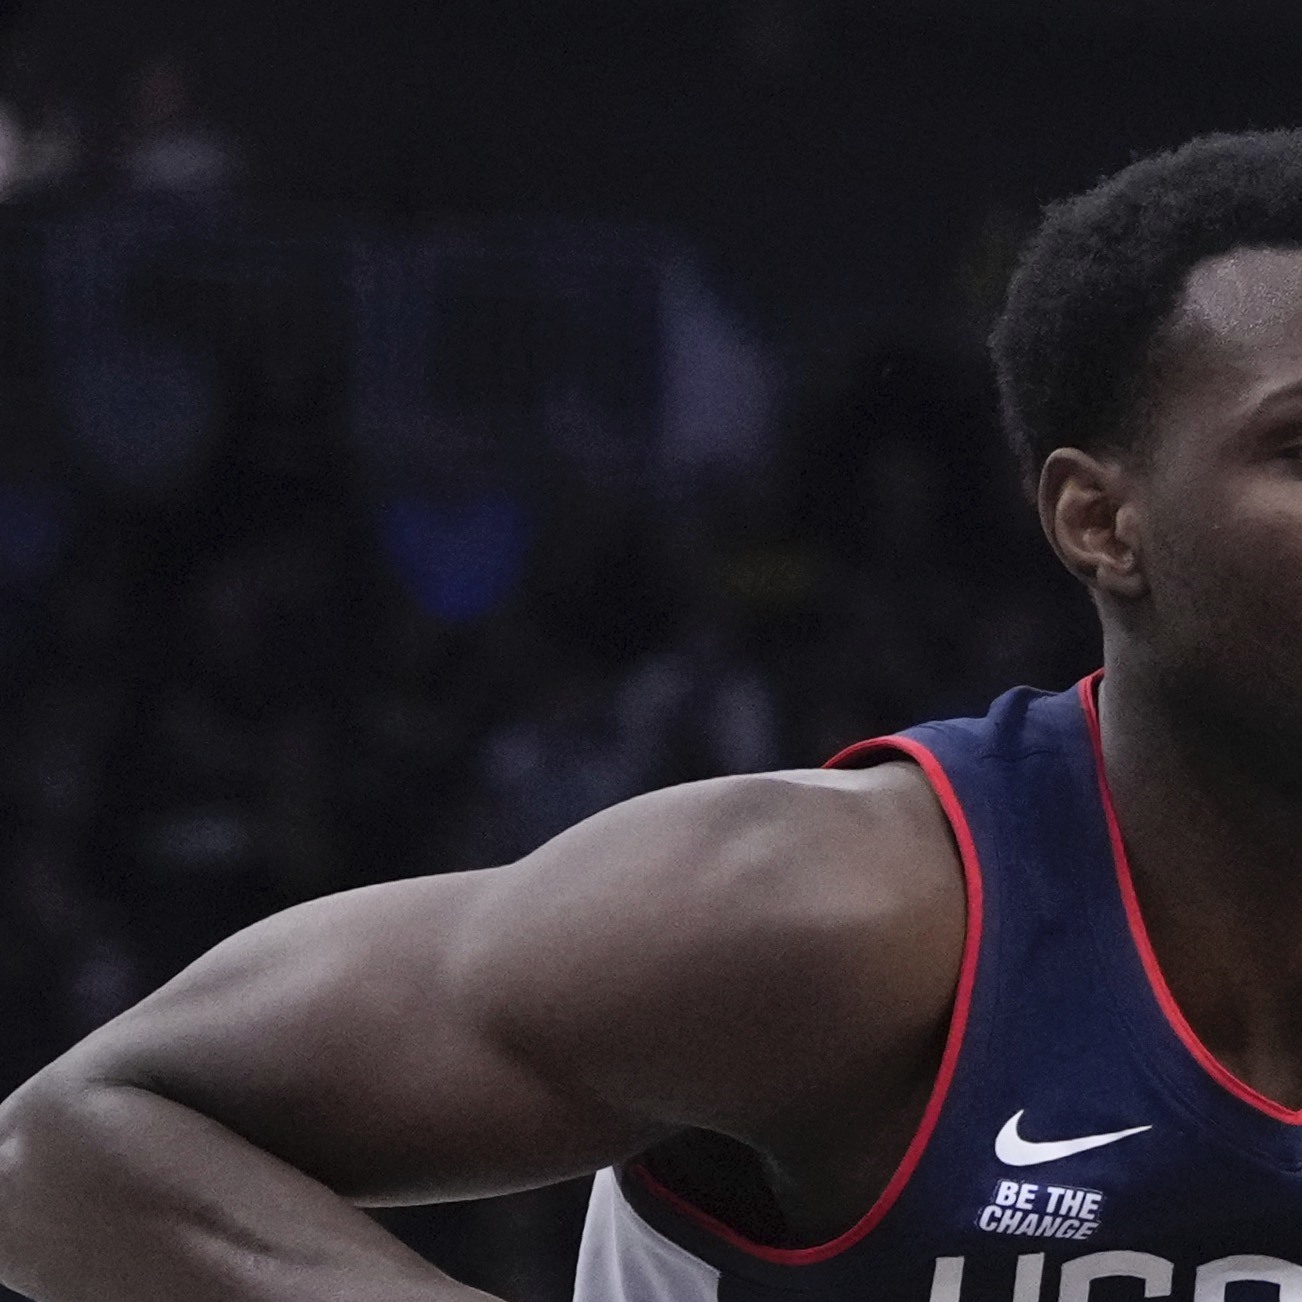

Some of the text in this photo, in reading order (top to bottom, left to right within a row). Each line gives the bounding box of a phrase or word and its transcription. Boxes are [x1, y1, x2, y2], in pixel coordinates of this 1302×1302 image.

[995, 1180, 1102, 1220] BE THE
[978, 1204, 1100, 1240] CHANGE
